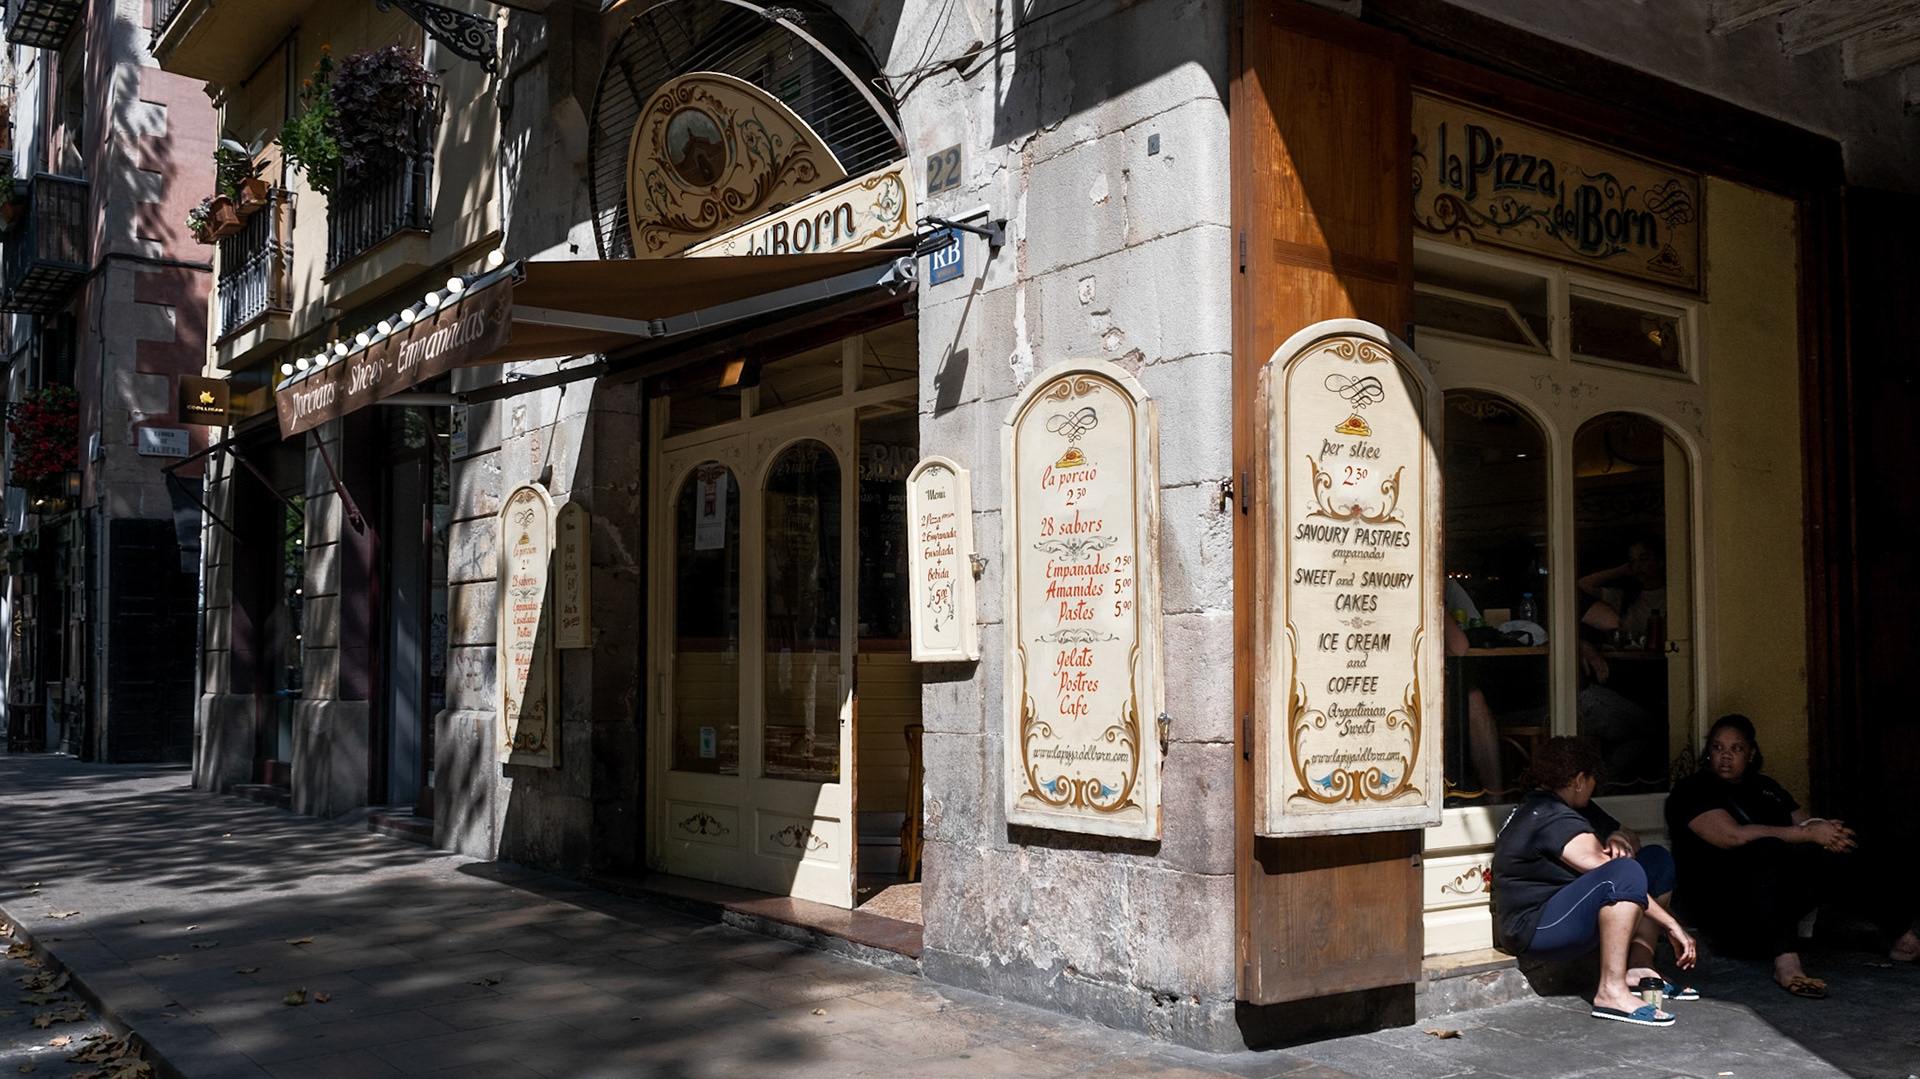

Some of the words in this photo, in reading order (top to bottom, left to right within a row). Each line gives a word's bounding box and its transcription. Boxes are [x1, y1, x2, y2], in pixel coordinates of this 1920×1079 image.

[927, 150, 961, 192] 22
[1464, 123, 1556, 200] Pizza
[770, 202, 856, 256] Born
[1578, 184, 1658, 250] Born
[933, 237, 961, 270] RB
[348, 358, 385, 396] Slices
[397, 308, 486, 374] Empanadas
[146, 445, 181, 455] CALDERS
[1320, 438, 1344, 461] per
[1349, 440, 1381, 459] slice
[1042, 465, 1055, 490] la
[1040, 517, 1054, 537] 28
[1059, 509, 1103, 536] sabors
[1295, 524, 1350, 544] SAVOURY
[1354, 528, 1411, 548] PASTRIES
[1046, 553, 1111, 583] Empanades
[1332, 548, 1385, 563] empanadas
[1045, 576, 1104, 602] Amanides
[1294, 568, 1336, 586] SWEET
[1336, 573, 1355, 587] and
[1361, 571, 1414, 589] SAVOURY
[1056, 599, 1095, 627] Pastes
[1335, 593, 1378, 612] CAKES
[1318, 633, 1339, 652] ICE
[1346, 633, 1391, 653] CREAM
[1346, 653, 1369, 668] and
[1057, 671, 1099, 699] Postres
[1327, 676, 1379, 694] COFFEE
[1327, 702, 1387, 725] Argentinian
[1339, 718, 1375, 738] Sweets
